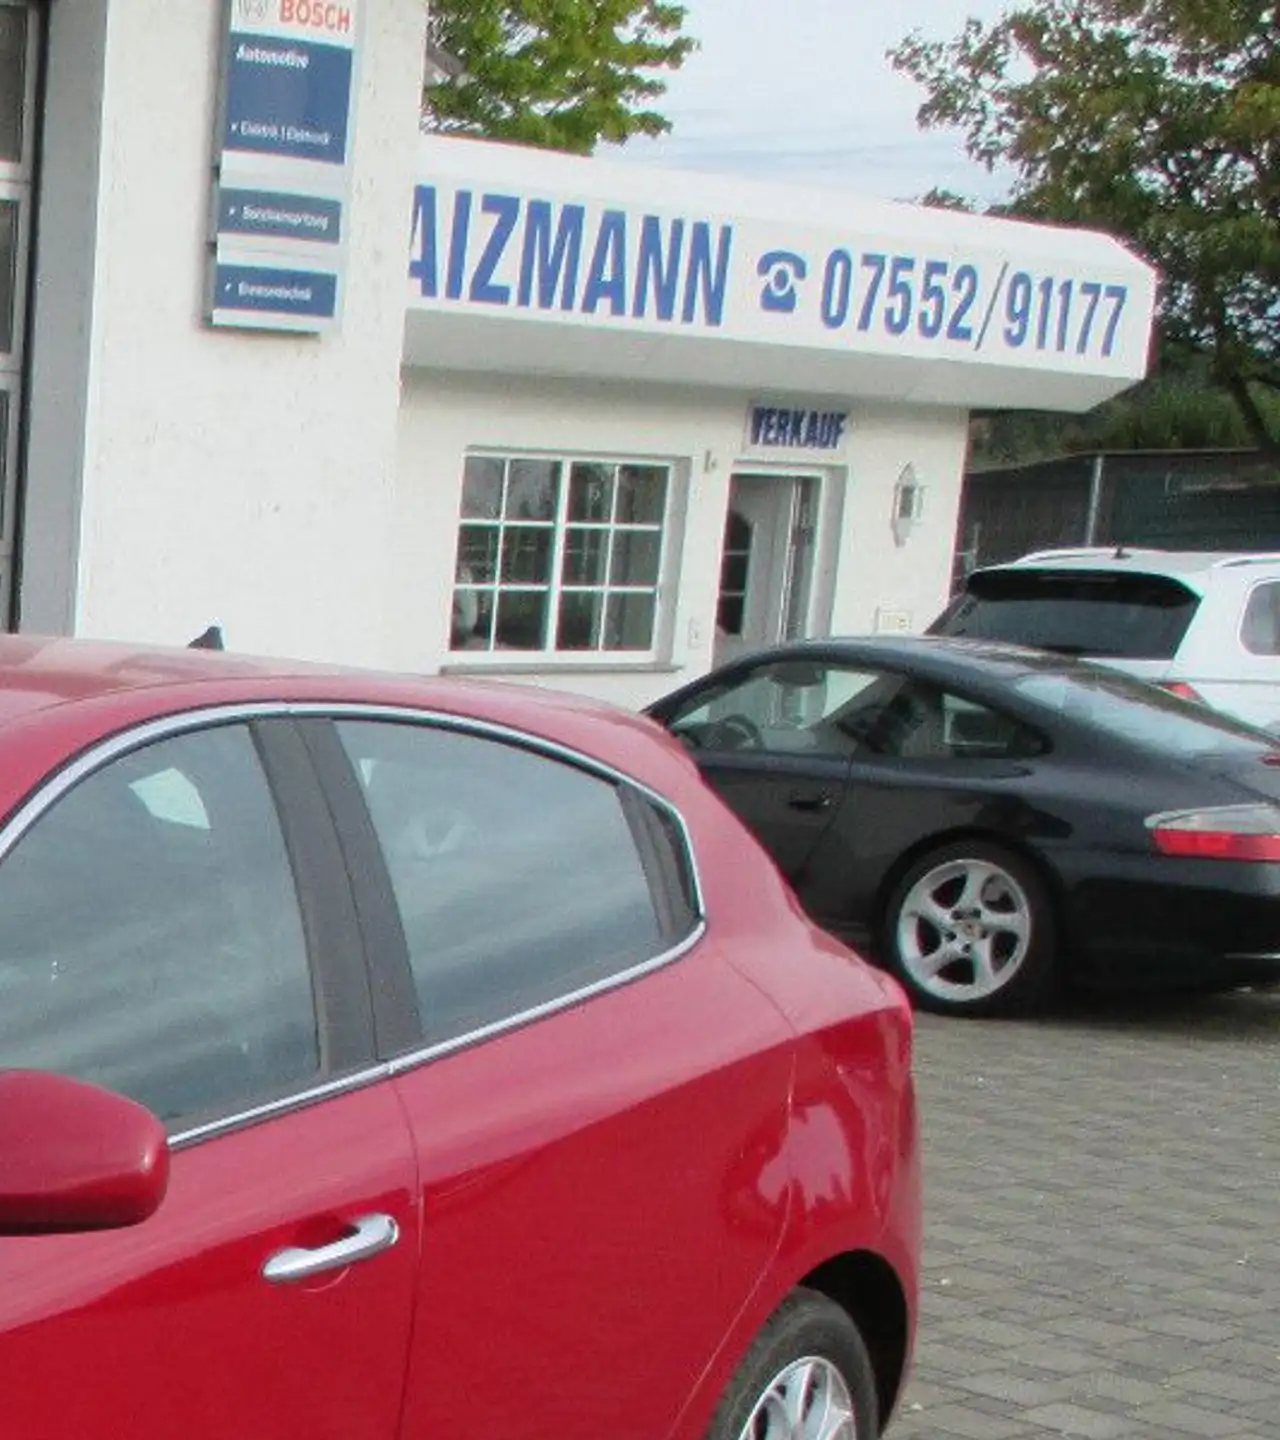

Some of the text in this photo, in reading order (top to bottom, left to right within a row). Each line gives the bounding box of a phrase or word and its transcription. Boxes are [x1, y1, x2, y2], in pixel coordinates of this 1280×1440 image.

[280, 0, 351, 33] BOSCH
[820, 248, 1128, 358] 07552/91177
[750, 406, 848, 449] VERKAUF
